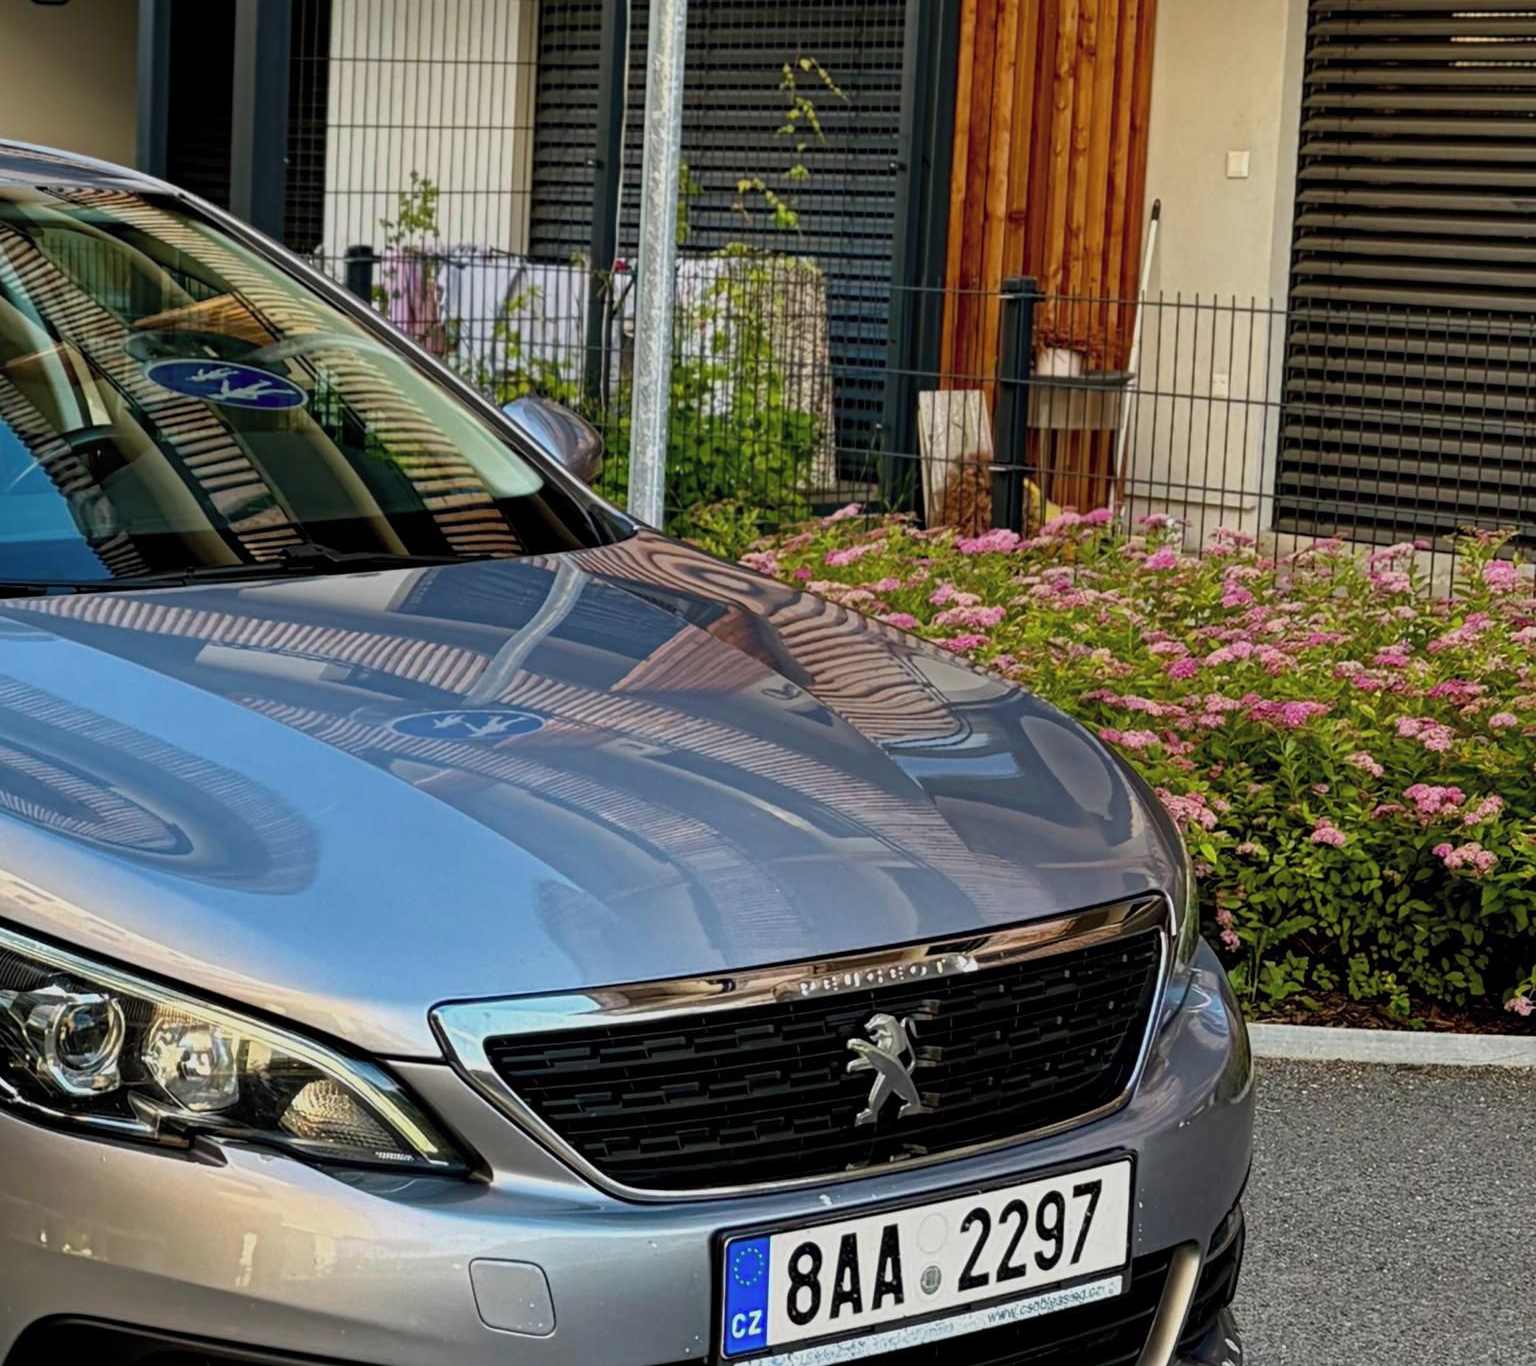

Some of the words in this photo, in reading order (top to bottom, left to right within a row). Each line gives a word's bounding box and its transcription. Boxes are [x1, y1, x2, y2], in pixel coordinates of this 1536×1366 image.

[786, 1223, 904, 1326] 8AA
[957, 1179, 1103, 1292] 2297
[731, 1310, 762, 1339] CZ
